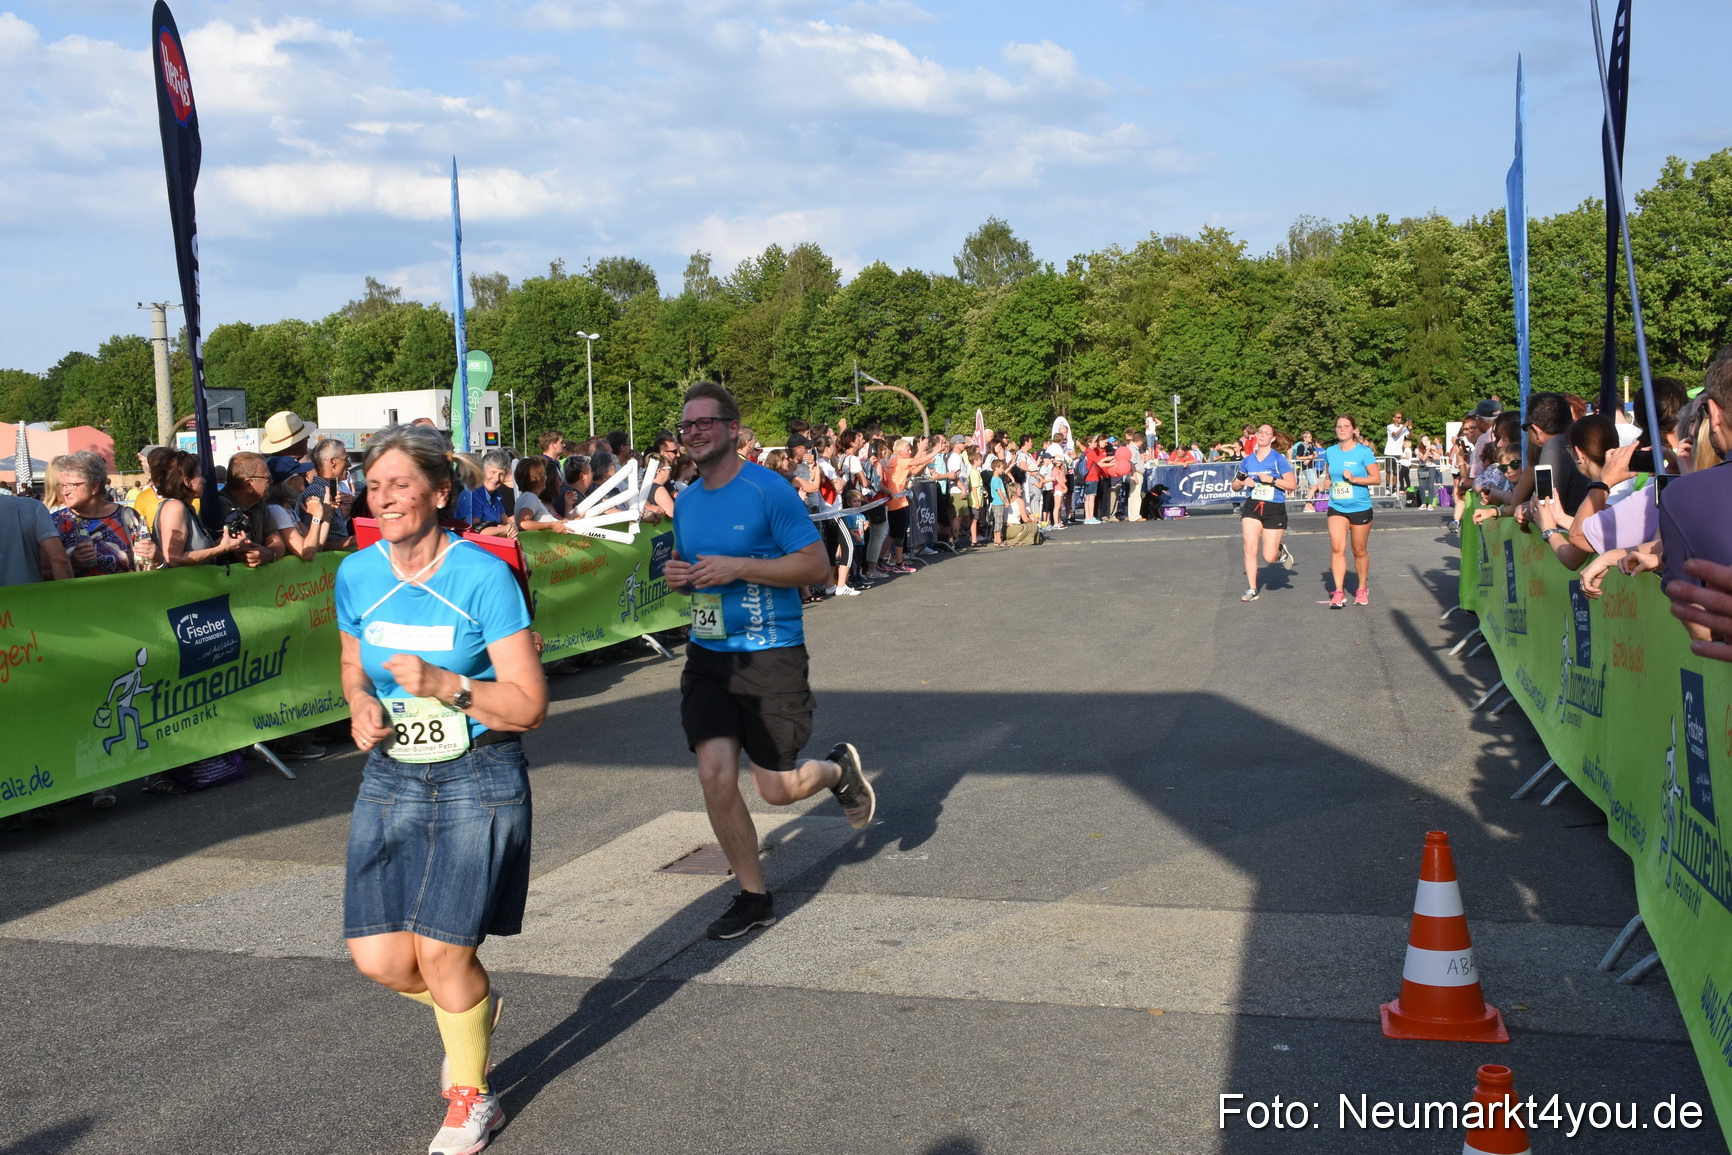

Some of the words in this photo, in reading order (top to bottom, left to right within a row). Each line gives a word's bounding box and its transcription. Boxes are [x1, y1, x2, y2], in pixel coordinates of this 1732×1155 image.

[1192, 479, 1248, 494] Fisch
[1197, 491, 1247, 500] AUTOMOBILE
[1333, 487, 1350, 495] 1854
[275, 566, 335, 608] Gesunde
[640, 578, 673, 607] firme
[308, 597, 337, 629] laufe
[692, 608, 717, 627] 734
[186, 619, 226, 640] Fischer
[194, 630, 228, 646] AUTOMOBILE
[151, 635, 291, 723] firmenlauf
[155, 704, 218, 740] neumarkt
[395, 719, 445, 746] 828
[1678, 787, 1732, 906] firmenla
